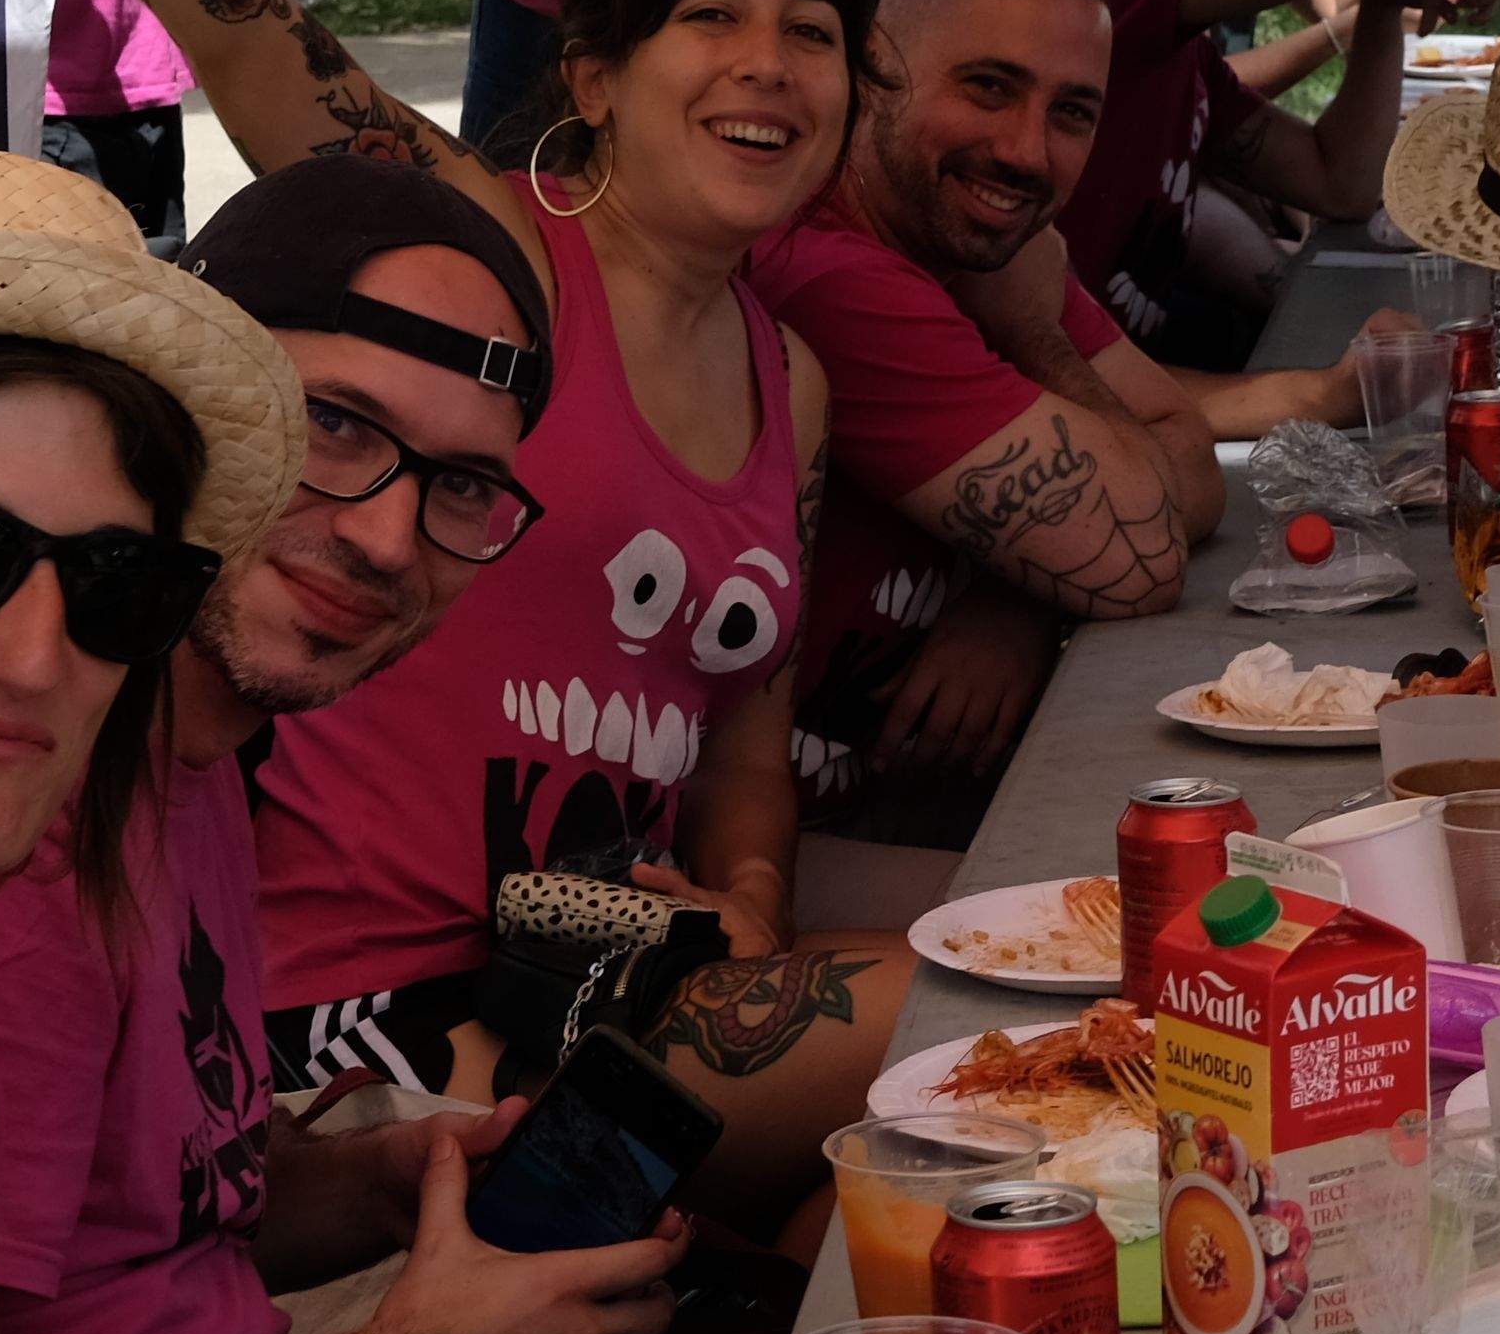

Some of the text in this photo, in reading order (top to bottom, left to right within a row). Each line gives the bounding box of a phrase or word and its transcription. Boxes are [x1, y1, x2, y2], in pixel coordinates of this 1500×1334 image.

[1158, 970, 1262, 1036] Alvalle
[1279, 973, 1418, 1037] Alvalle
[1344, 1031, 1358, 1047] EL
[1344, 1039, 1411, 1063] RESPETO
[1165, 1040, 1253, 1090] SALMOREJO
[1344, 1060, 1383, 1078] SABE
[1344, 1074, 1395, 1096] MEJOR
[1310, 1204, 1347, 1226] TRA
[1314, 1309, 1355, 1330] FRES
